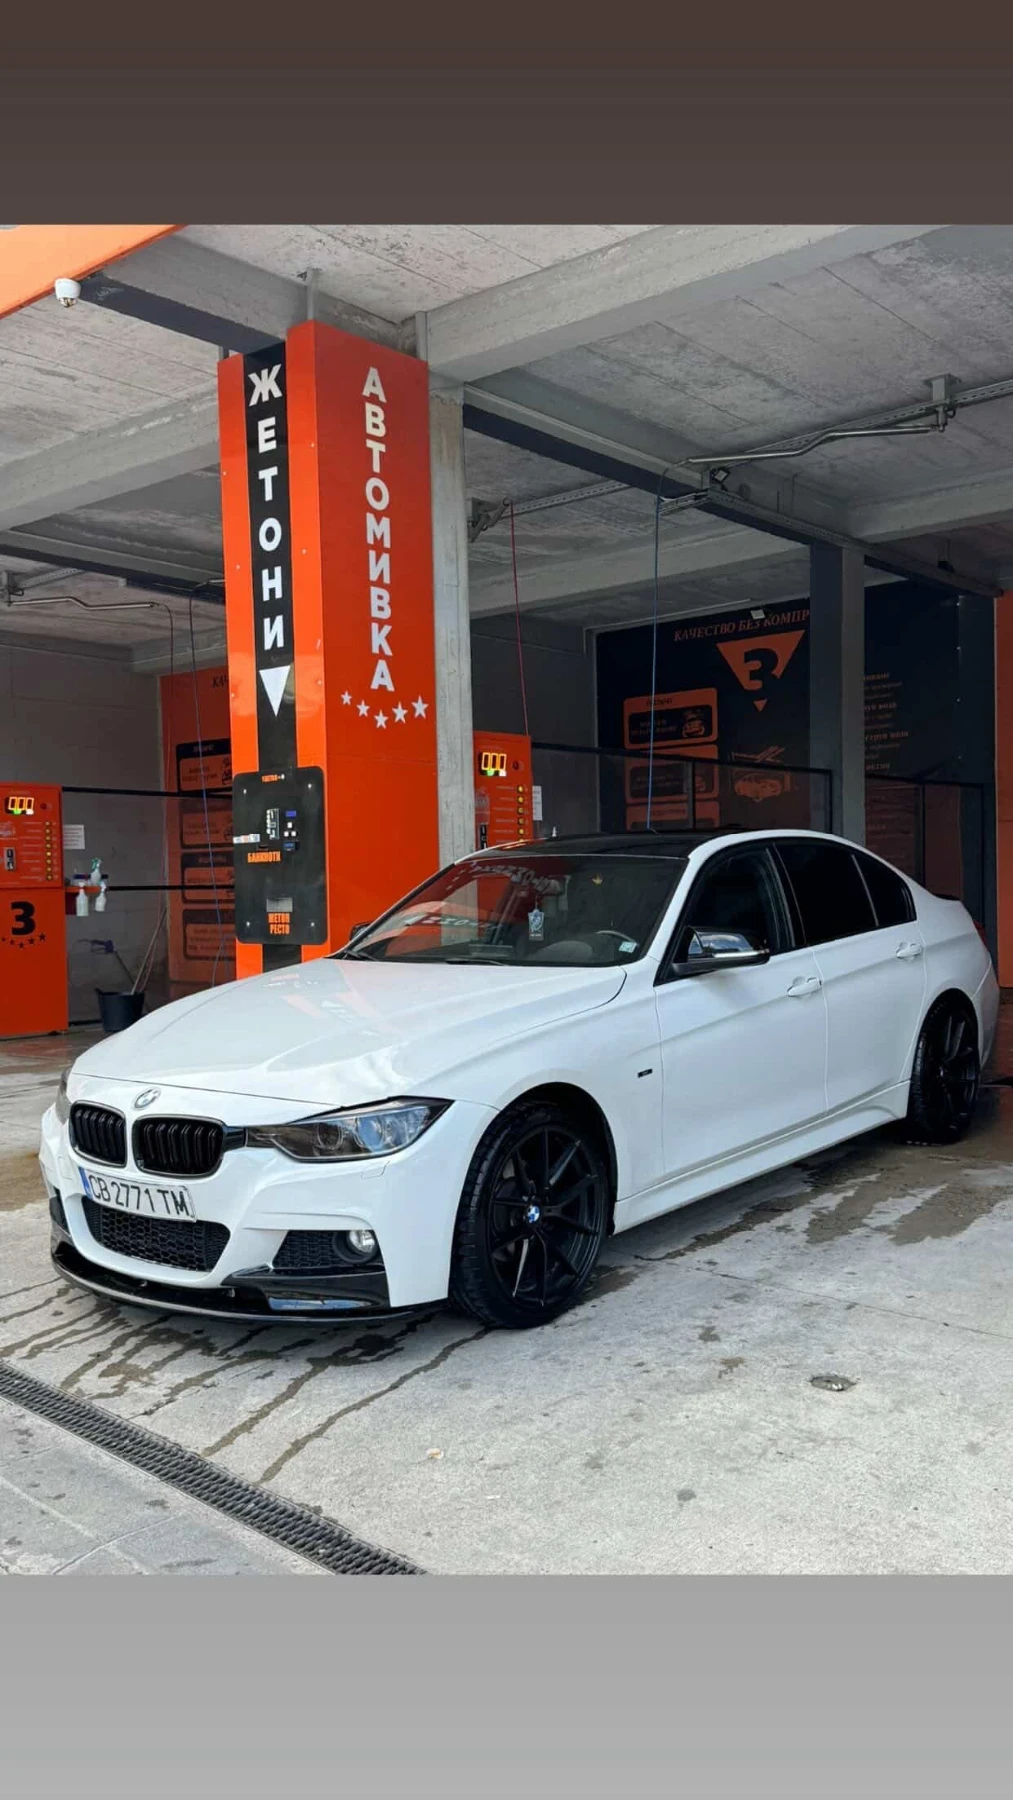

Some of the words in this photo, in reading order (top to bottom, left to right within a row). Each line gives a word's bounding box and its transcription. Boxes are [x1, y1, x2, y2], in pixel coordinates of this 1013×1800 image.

[249, 363, 285, 651] ЖЕТОНИ
[362, 366, 395, 692] АВТОМИВКА
[674, 622, 736, 641] КАЧЕСТВО
[247, 851, 281, 863] БАНКНОТИ
[11, 901, 35, 936] 3
[269, 923, 290, 935] РЕСТО
[111, 1181, 155, 1213] 2771
